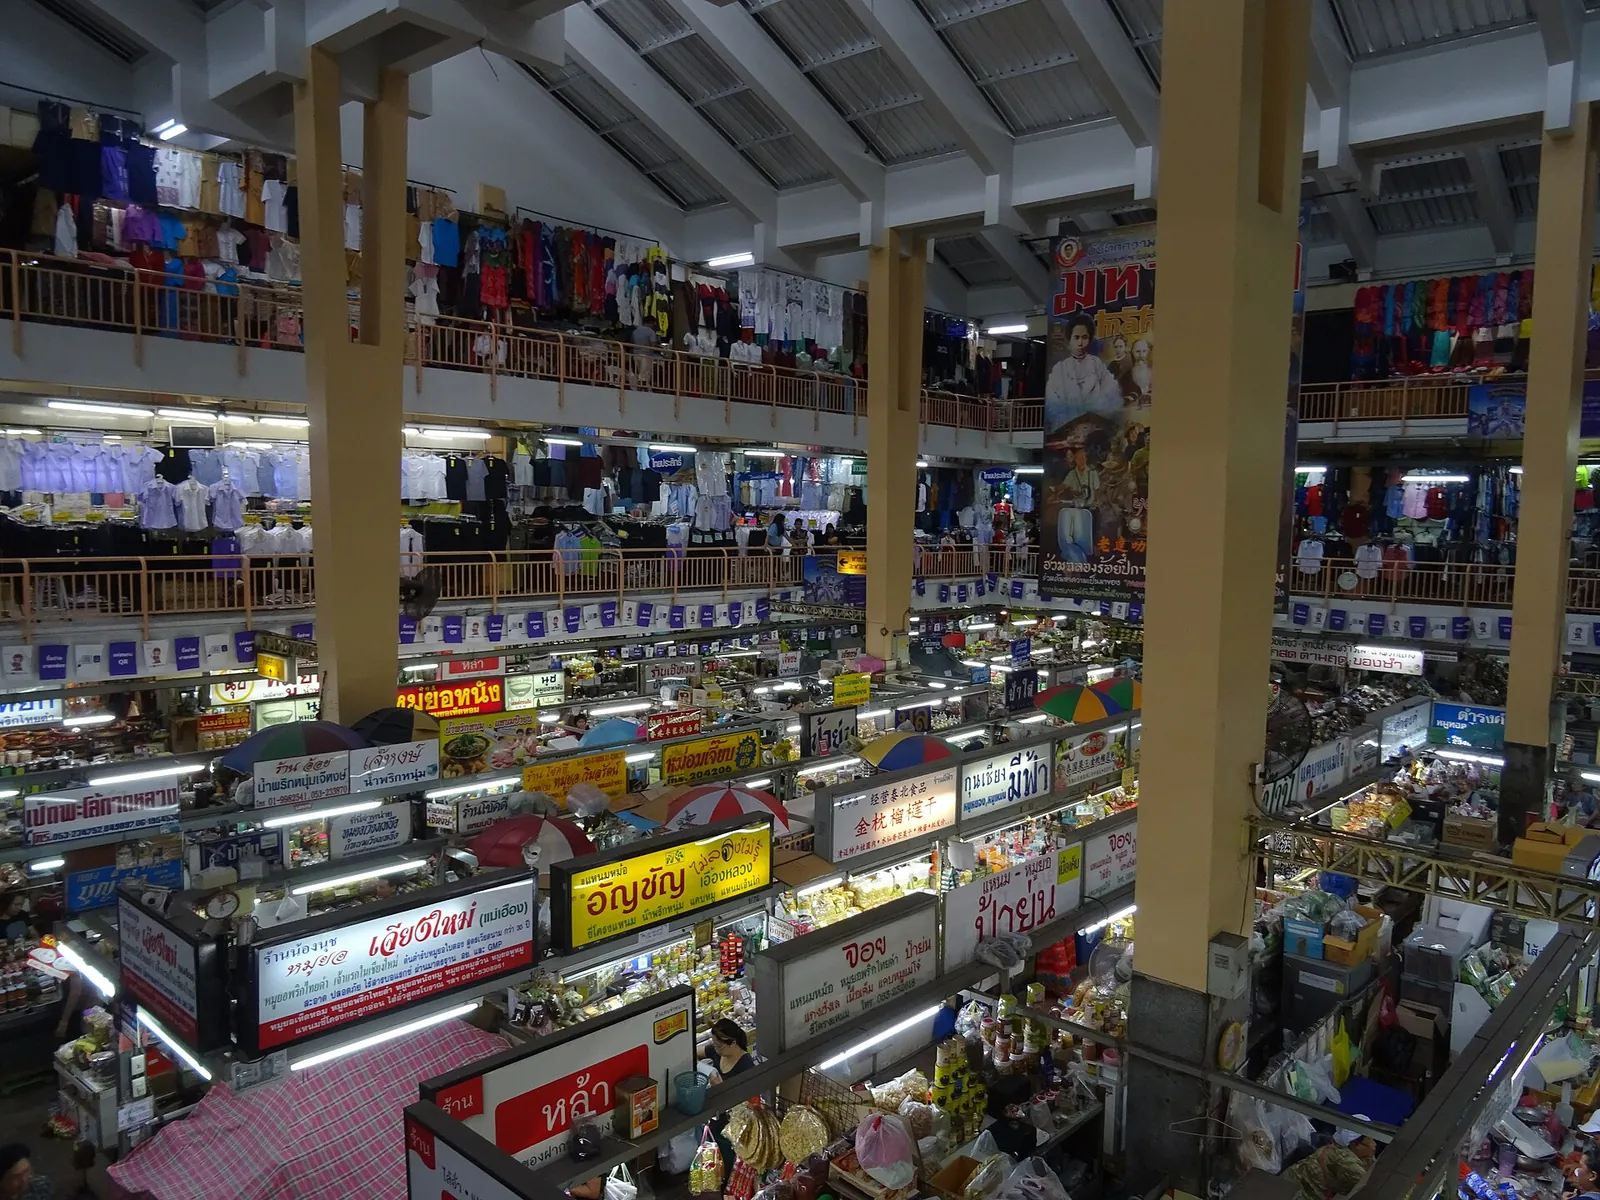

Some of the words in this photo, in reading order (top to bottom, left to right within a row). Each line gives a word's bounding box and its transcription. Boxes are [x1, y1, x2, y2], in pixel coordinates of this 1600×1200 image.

[276, 762, 298, 775] ร้าน
[690, 766, 732, 781] 204206
[1008, 750, 1048, 802] มีฟ้า
[587, 866, 685, 916] อัญชัญ
[982, 875, 1011, 894] แหนม
[1025, 857, 1052, 881] หมูยอ
[264, 937, 337, 966] ร้านน้องนุช
[286, 948, 349, 978] หมูยอ
[487, 941, 503, 952] GMP
[842, 936, 886, 969] จอย
[264, 977, 329, 1010] หมูยอพริกไทยดำ
[442, 1093, 473, 1115] ร้าน
[542, 1073, 609, 1133] หล้า
